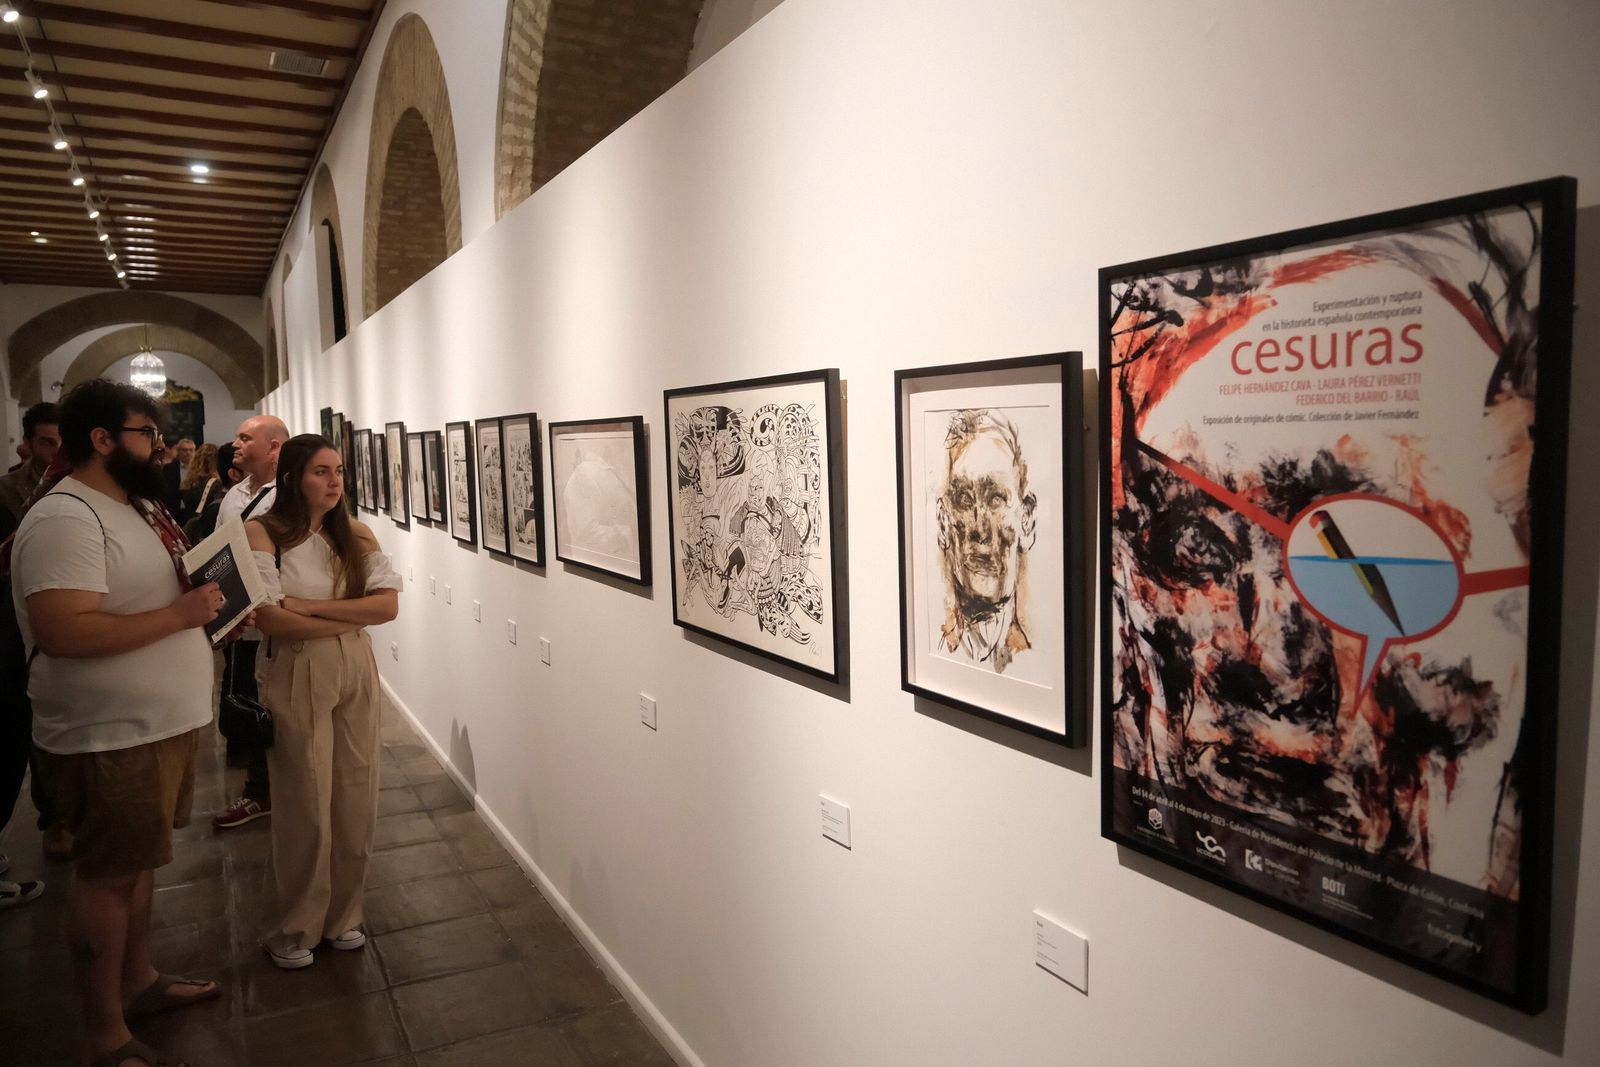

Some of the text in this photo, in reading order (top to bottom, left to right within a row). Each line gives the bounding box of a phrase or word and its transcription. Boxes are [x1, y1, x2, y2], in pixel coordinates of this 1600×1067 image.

[1313, 290, 1423, 314] Experimentación y ruptura
[1262, 305, 1422, 332] en la historieta española contemporánea
[1231, 323, 1424, 375] cesuras
[1219, 372, 1421, 395] FELIPE HERNÁNDEZ CAVA LAURA PÉREZ VERNETTI
[1296, 393, 1335, 405] FEDERICO
[1336, 392, 1352, 404] DEL
[1355, 390, 1388, 402] BARRIO
[1203, 415, 1233, 425] Exposición
[1234, 414, 1242, 423] de
[1244, 413, 1274, 425] originales
[1276, 413, 1284, 422] de
[1309, 411, 1342, 422] Colección
[1344, 411, 1353, 421] de
[1355, 411, 1376, 421] Javier
[1378, 409, 1420, 420] Fernández
[205, 554, 230, 579] cesuras
